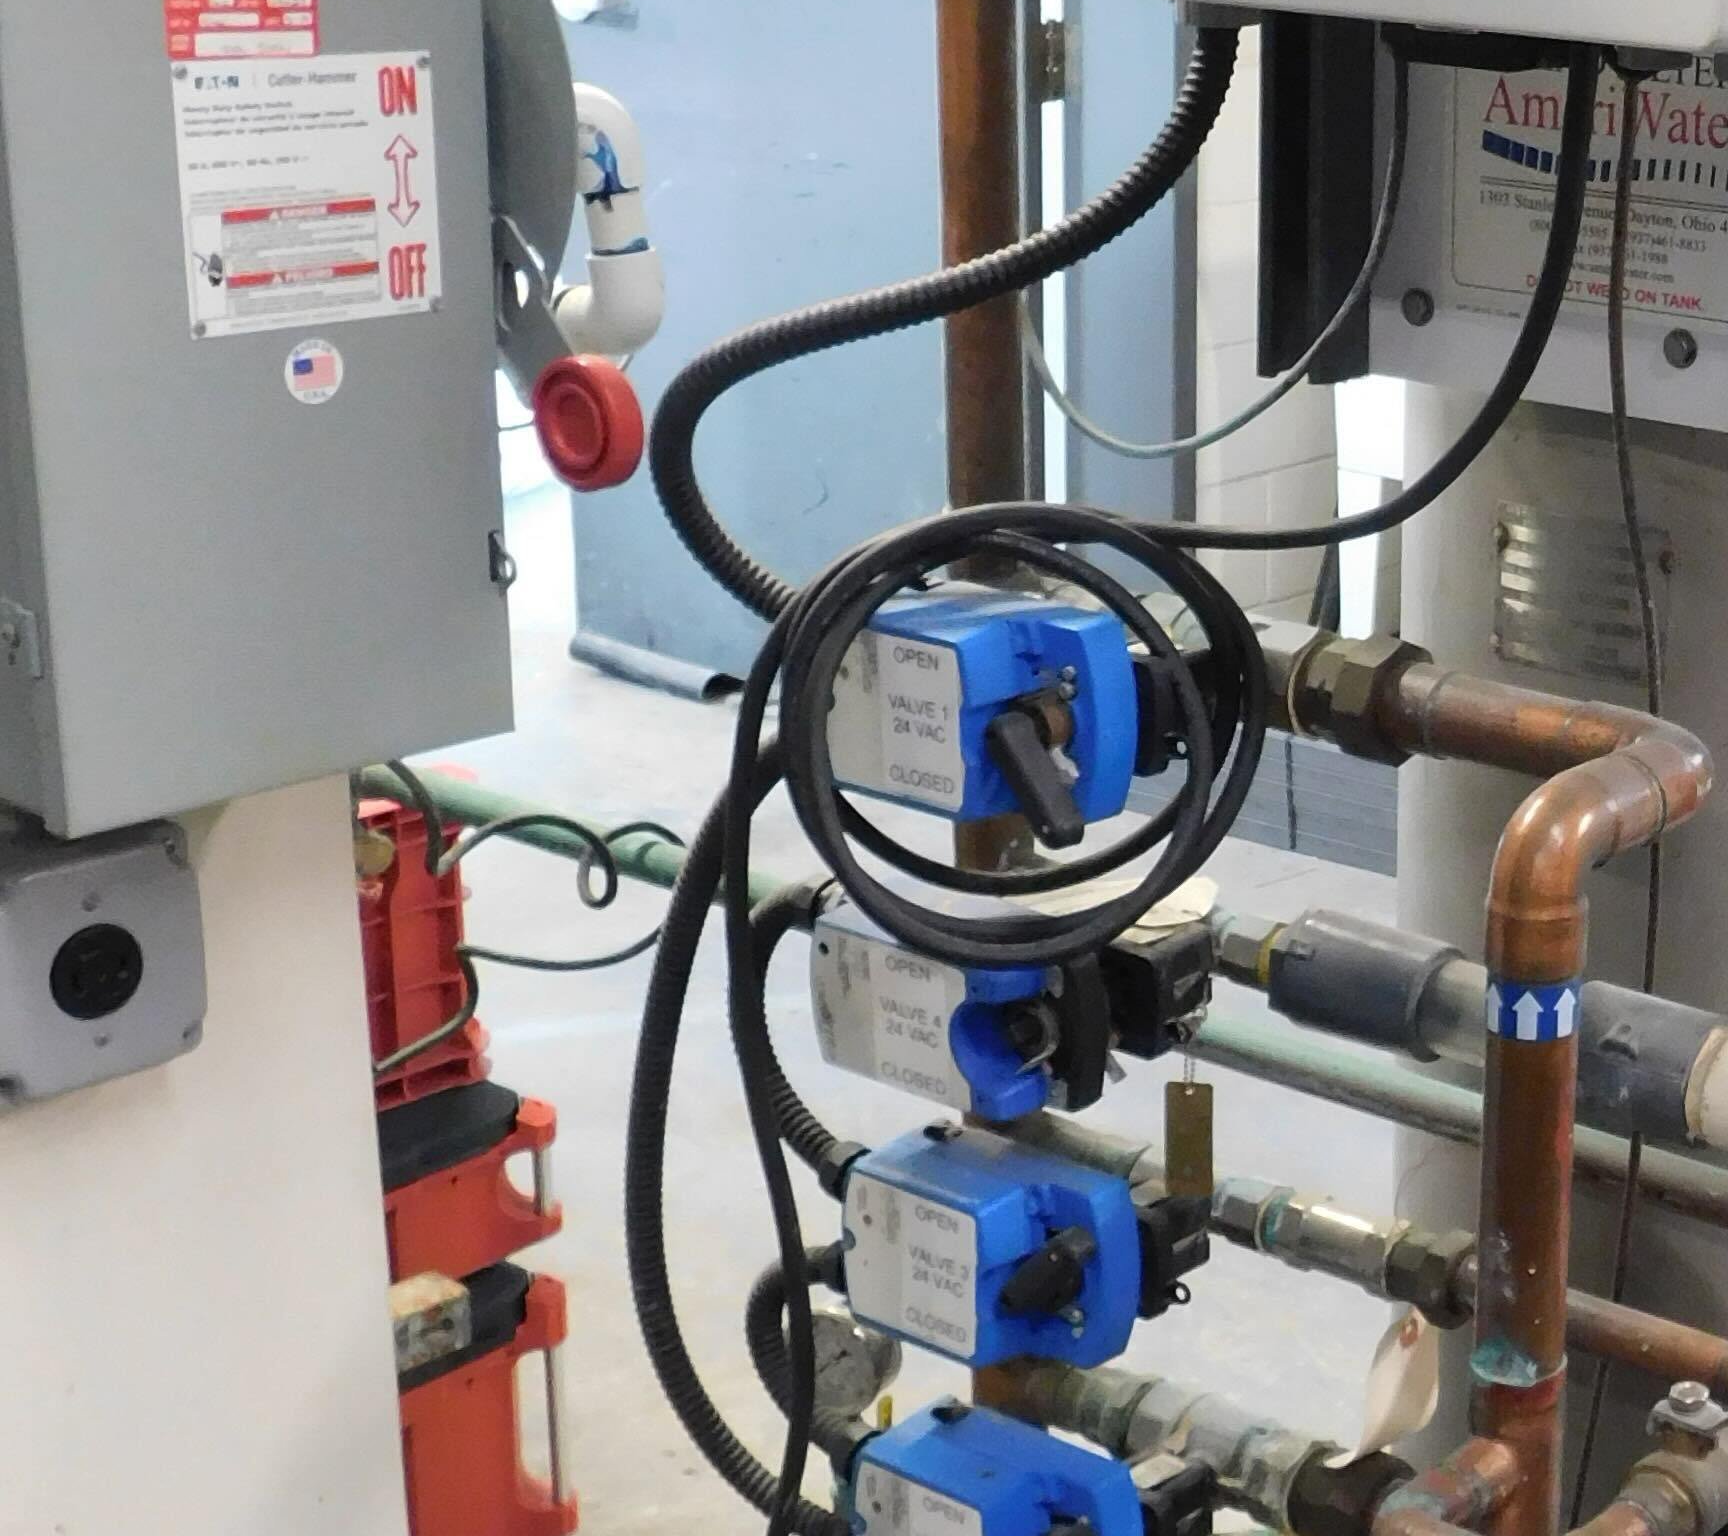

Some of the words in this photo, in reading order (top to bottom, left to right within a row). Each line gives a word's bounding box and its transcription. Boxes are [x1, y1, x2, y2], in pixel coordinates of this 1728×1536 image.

[378, 66, 418, 118] ON
[1682, 215, 1716, 233] Ohio
[389, 242, 428, 302] OFF
[1587, 281, 1630, 302] WED
[1635, 289, 1657, 304] ON
[893, 645, 940, 671] OPEN
[888, 694, 937, 720] VALVE
[942, 705, 950, 721] 1
[893, 717, 911, 735] 24
[914, 722, 947, 745] VAC
[889, 764, 956, 795] CLOSED
[884, 954, 932, 983] OPEN
[879, 996, 928, 1026] VALVE
[914, 1204, 961, 1235] OPEN
[908, 1243, 956, 1276] VALVE
